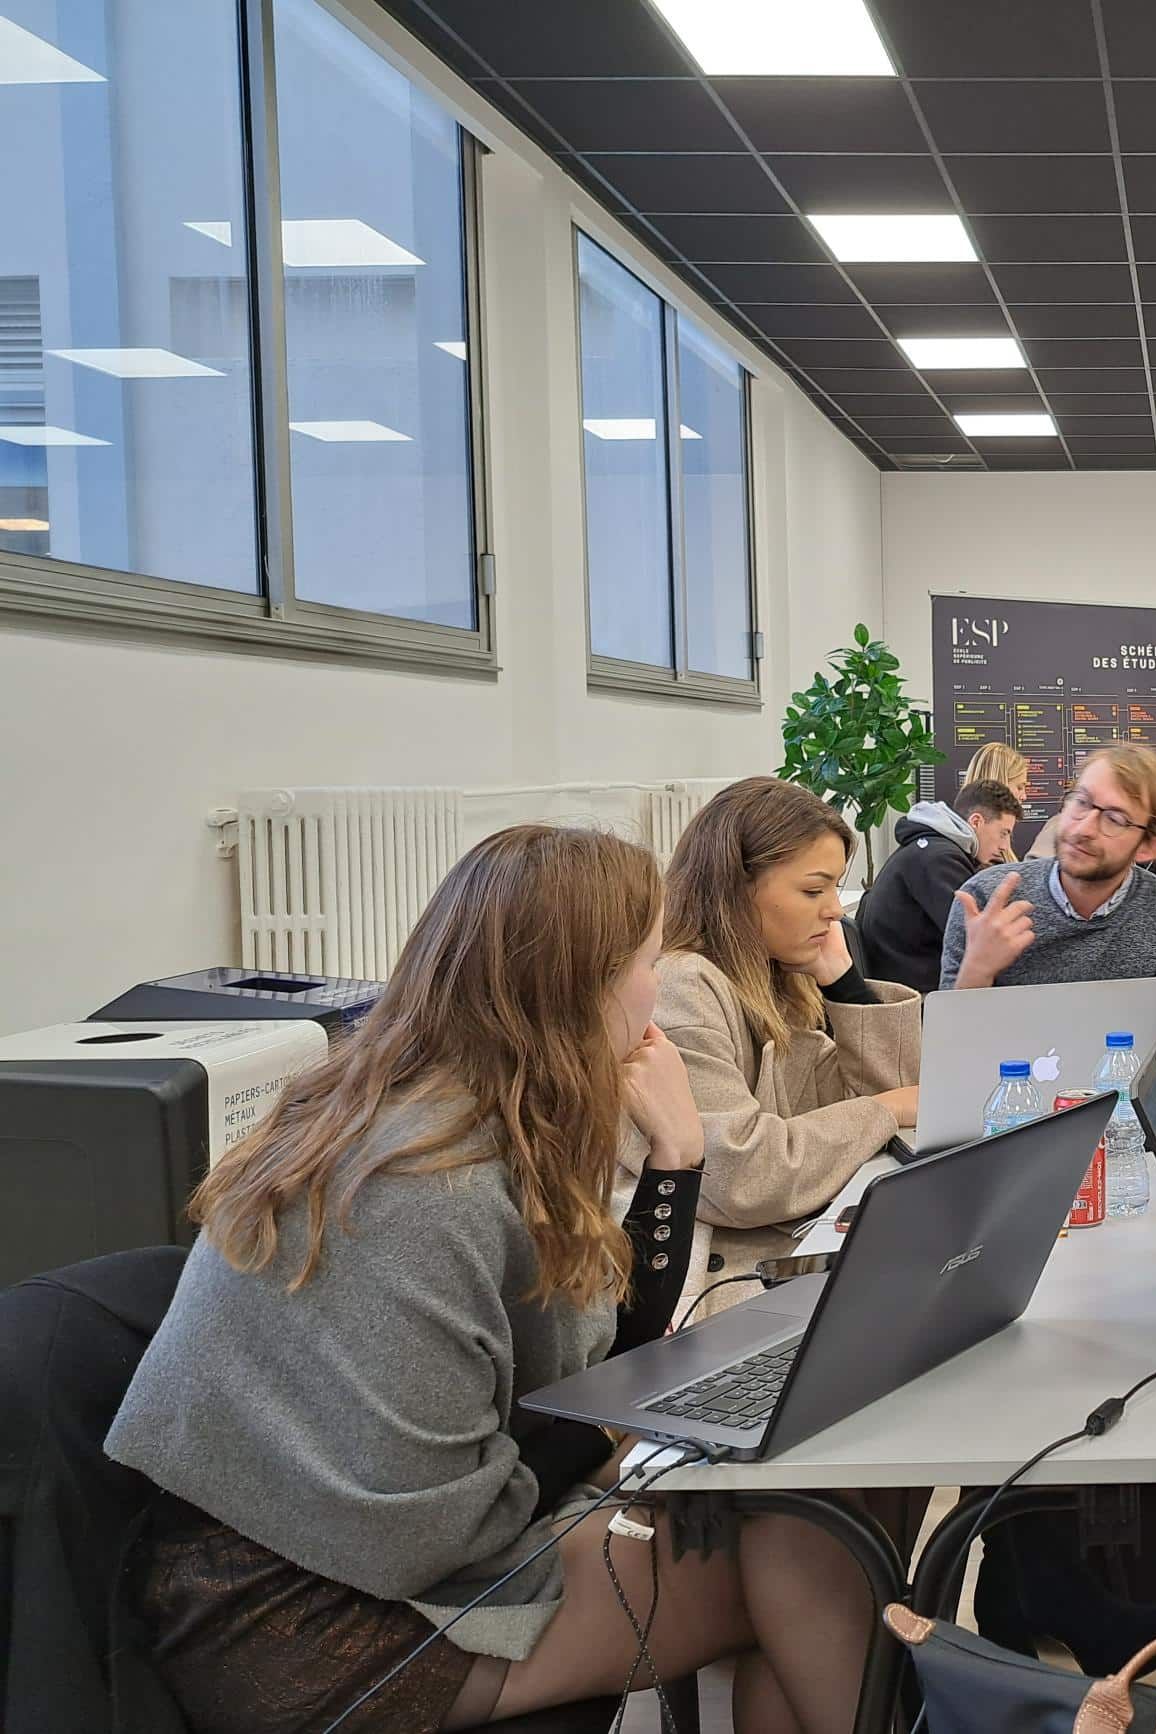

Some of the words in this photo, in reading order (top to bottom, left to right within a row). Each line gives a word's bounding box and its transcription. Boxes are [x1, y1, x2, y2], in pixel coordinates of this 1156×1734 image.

[952, 617, 1009, 647] ESP
[1093, 657, 1118, 669] DES
[224, 1105, 256, 1127] MÉTAUX
[225, 1123, 257, 1146] PLASTI
[939, 1244, 984, 1275] ASUS
